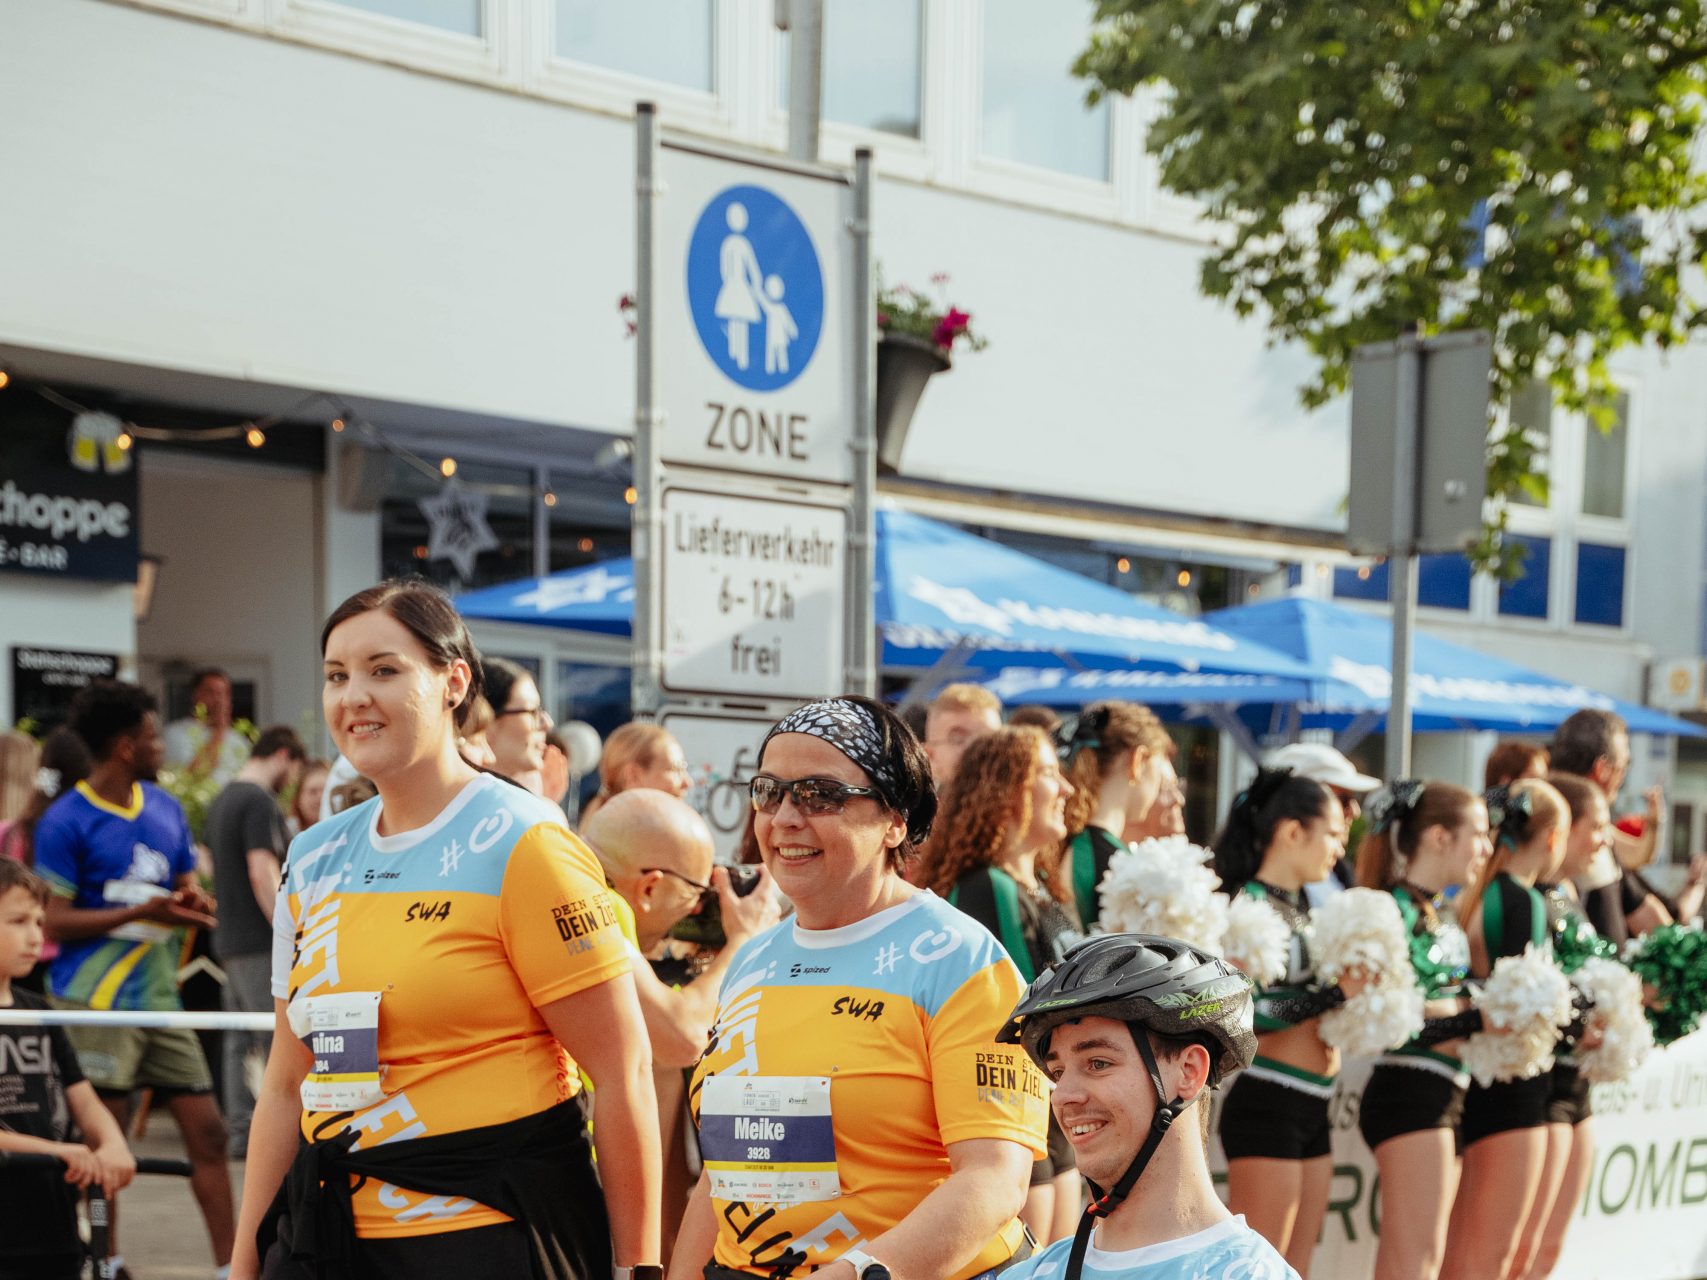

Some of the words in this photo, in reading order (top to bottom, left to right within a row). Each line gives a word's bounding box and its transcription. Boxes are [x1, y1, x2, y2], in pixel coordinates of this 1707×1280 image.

[706, 402, 809, 461] ZONE
[0, 480, 131, 543] hoppe
[674, 512, 836, 568] Lieferverkehr
[730, 634, 782, 676] frei
[404, 900, 452, 923] SWA
[551, 899, 588, 919] DEIN
[555, 910, 600, 942] DEIN
[803, 965, 832, 975] spized
[831, 996, 886, 1023] SWA
[1179, 1002, 1223, 1021] LAZER
[975, 1052, 1014, 1066] DEIN
[975, 1063, 1017, 1091] DEIN
[734, 1116, 786, 1141] Meike
[747, 1146, 771, 1160] 3928
